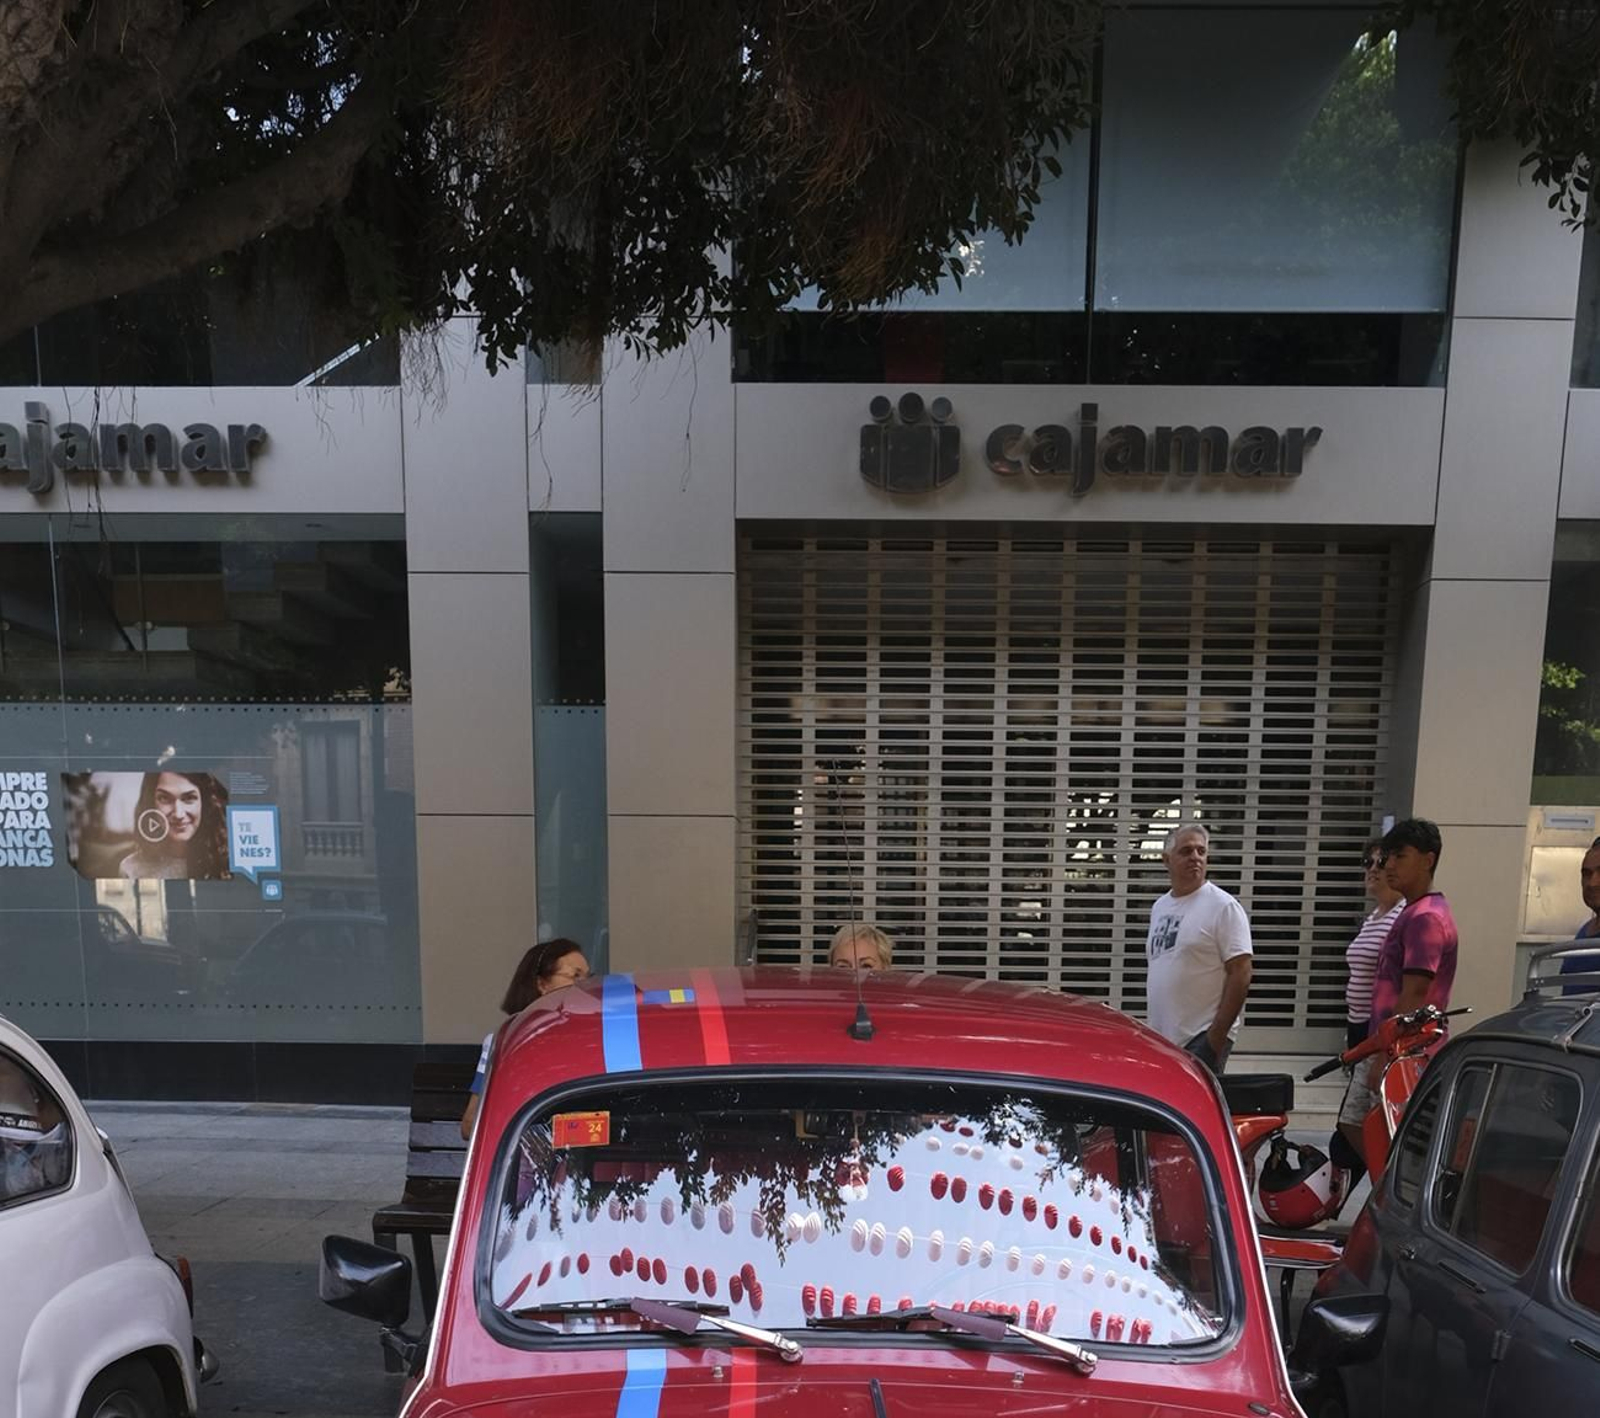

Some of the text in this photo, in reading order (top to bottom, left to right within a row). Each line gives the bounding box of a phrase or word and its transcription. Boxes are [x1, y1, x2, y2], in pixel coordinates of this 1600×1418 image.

[985, 403, 1323, 497] cajamar
[0, 791, 49, 810] ADO
[0, 810, 52, 829] ARA
[238, 822, 252, 832] TE
[239, 834, 259, 845] VIE
[240, 847, 272, 858] NES?
[588, 1122, 602, 1133] 24
